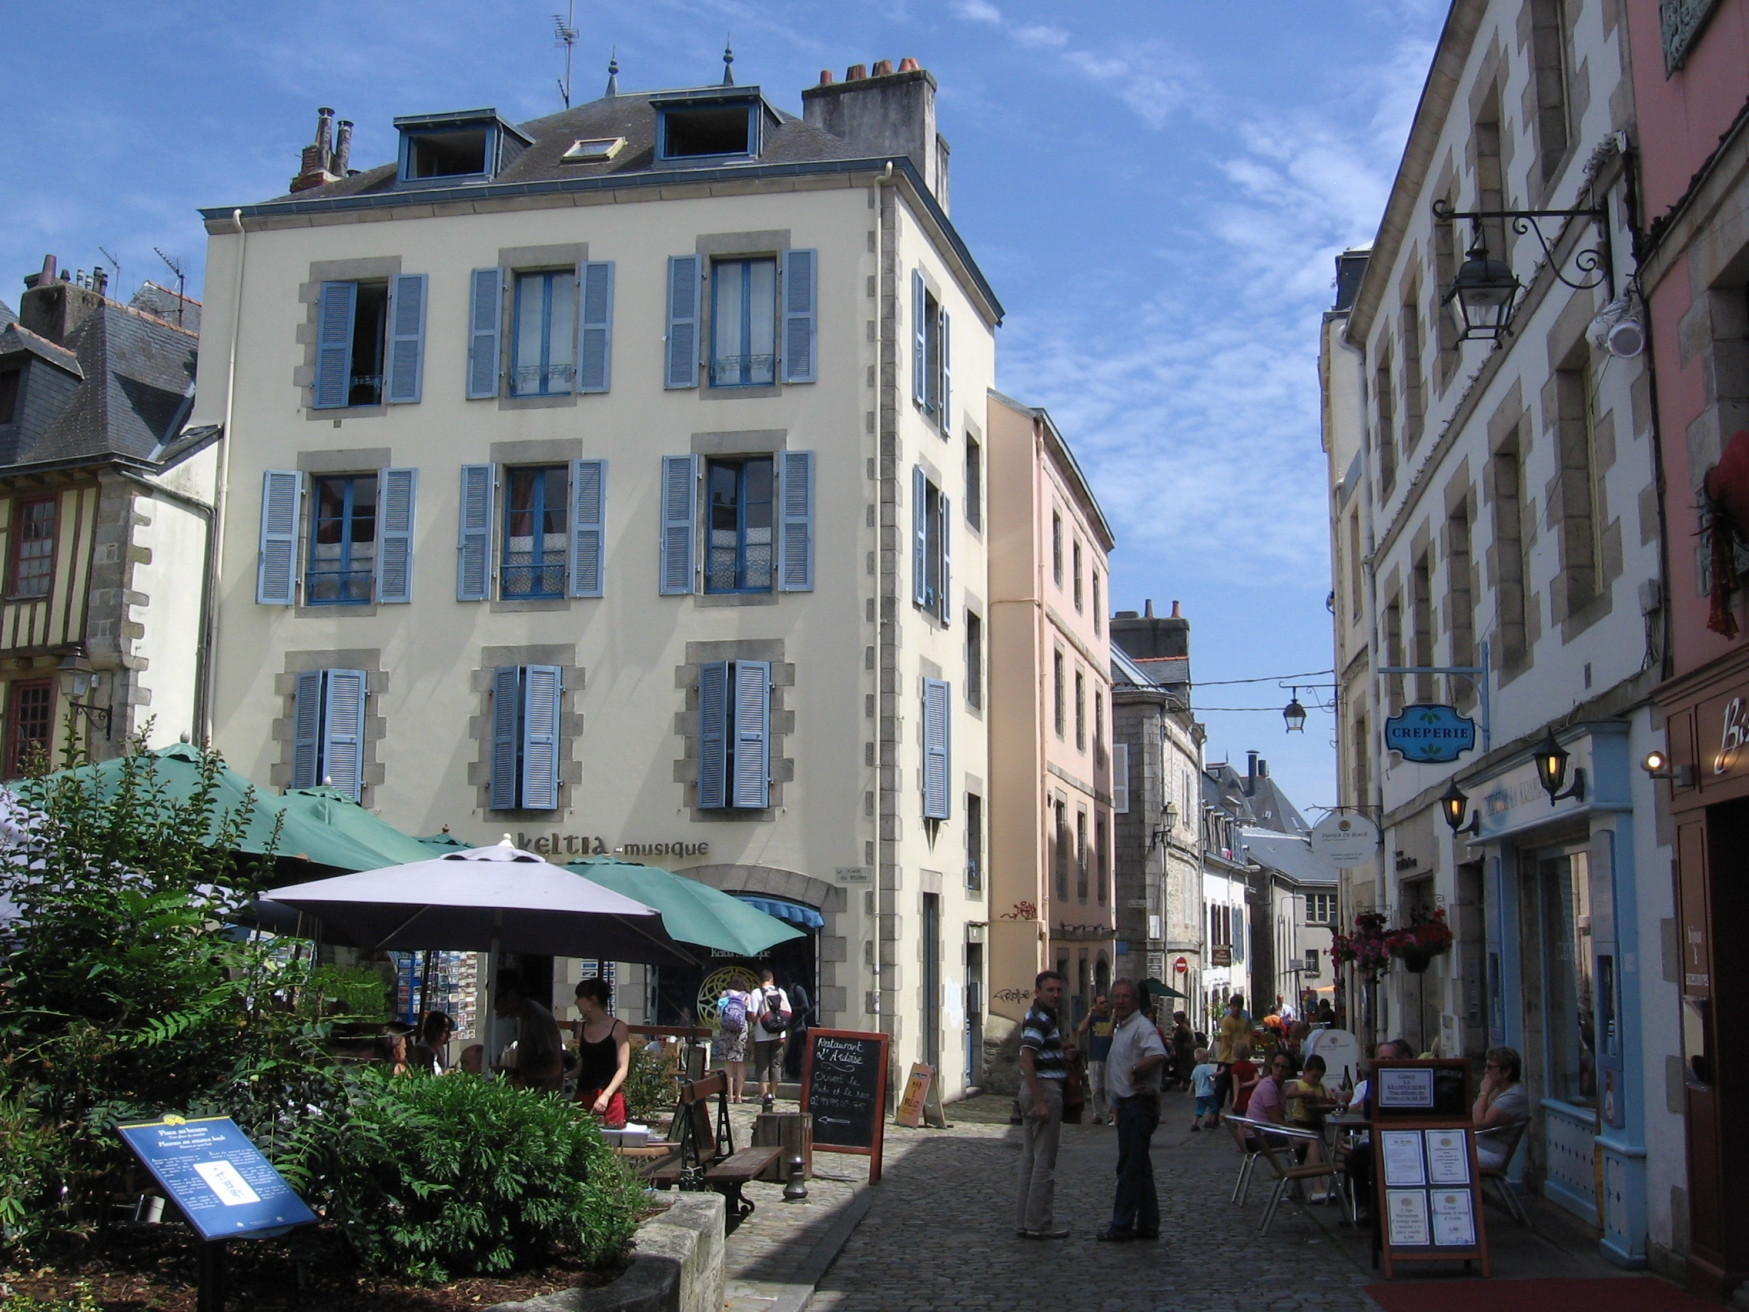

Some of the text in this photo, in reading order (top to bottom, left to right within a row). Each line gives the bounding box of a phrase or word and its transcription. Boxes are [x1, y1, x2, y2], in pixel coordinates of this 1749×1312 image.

[1391, 727, 1469, 739] CREPERIE
[1713, 697, 1749, 775] Bi
[624, 840, 709, 858] musique
